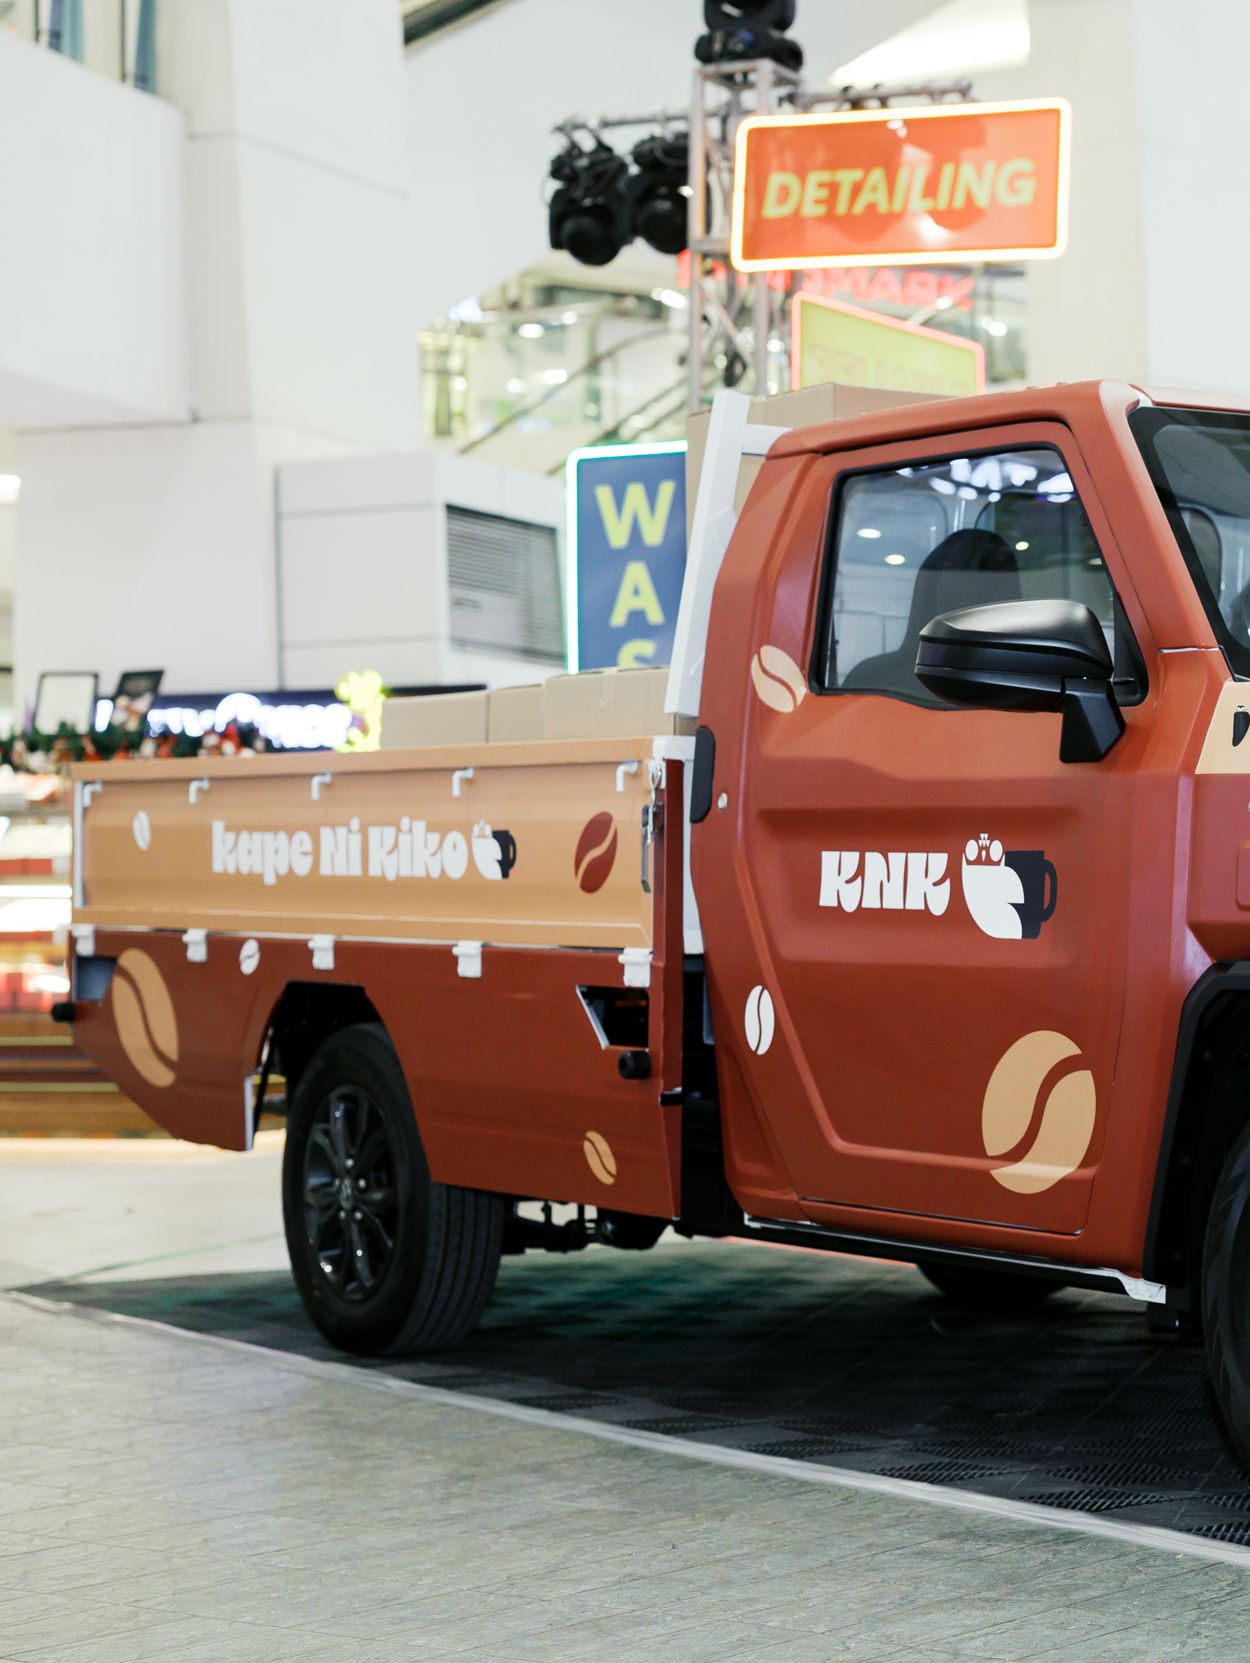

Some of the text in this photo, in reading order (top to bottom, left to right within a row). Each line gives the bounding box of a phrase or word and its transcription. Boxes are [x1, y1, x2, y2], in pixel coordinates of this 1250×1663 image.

[762, 159, 1036, 218] DETAILING
[211, 816, 468, 885] kape Ni Kiko
[819, 850, 951, 916] KNK
